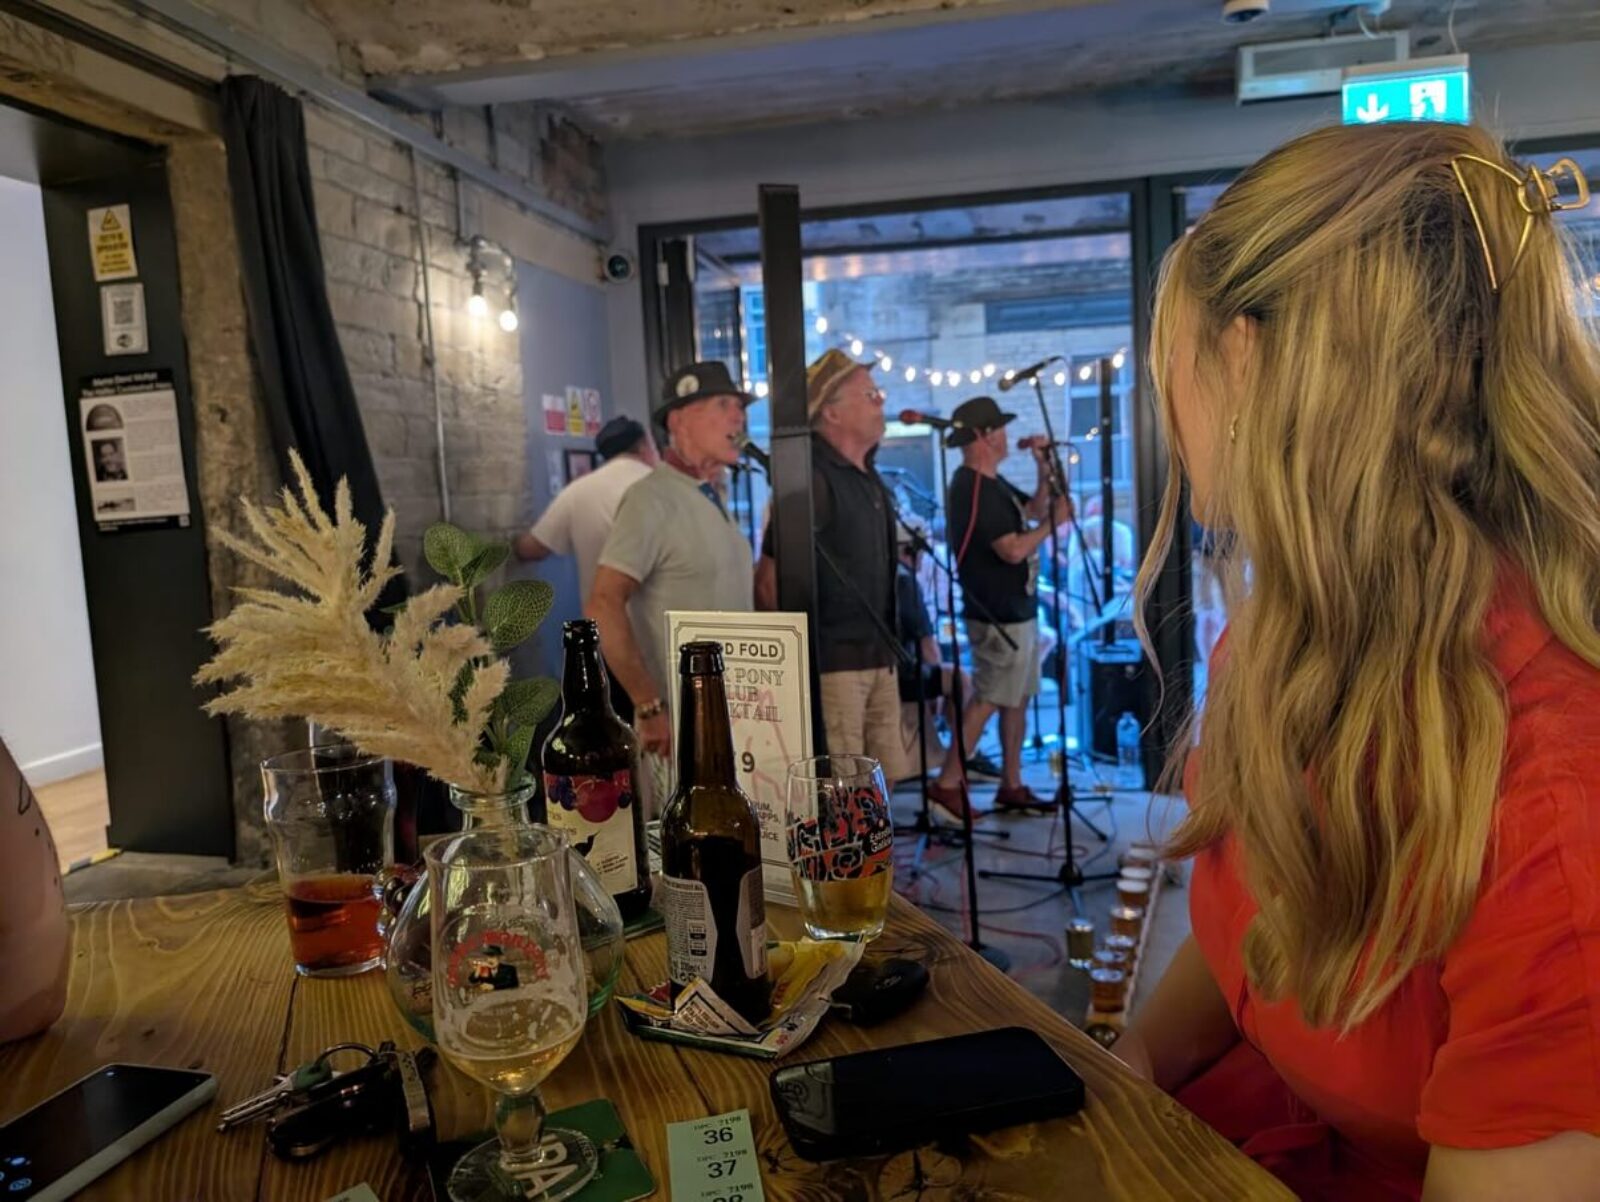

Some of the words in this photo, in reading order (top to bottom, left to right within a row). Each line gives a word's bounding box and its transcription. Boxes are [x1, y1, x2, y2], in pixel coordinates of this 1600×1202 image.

[725, 643, 734, 655] D
[740, 643, 778, 658] FOLD
[734, 667, 784, 687] PONY
[726, 685, 759, 702] LUB
[730, 702, 783, 722] KTAIL
[742, 751, 755, 773] 9
[703, 1126, 734, 1145] 36
[707, 1159, 737, 1179] 37
